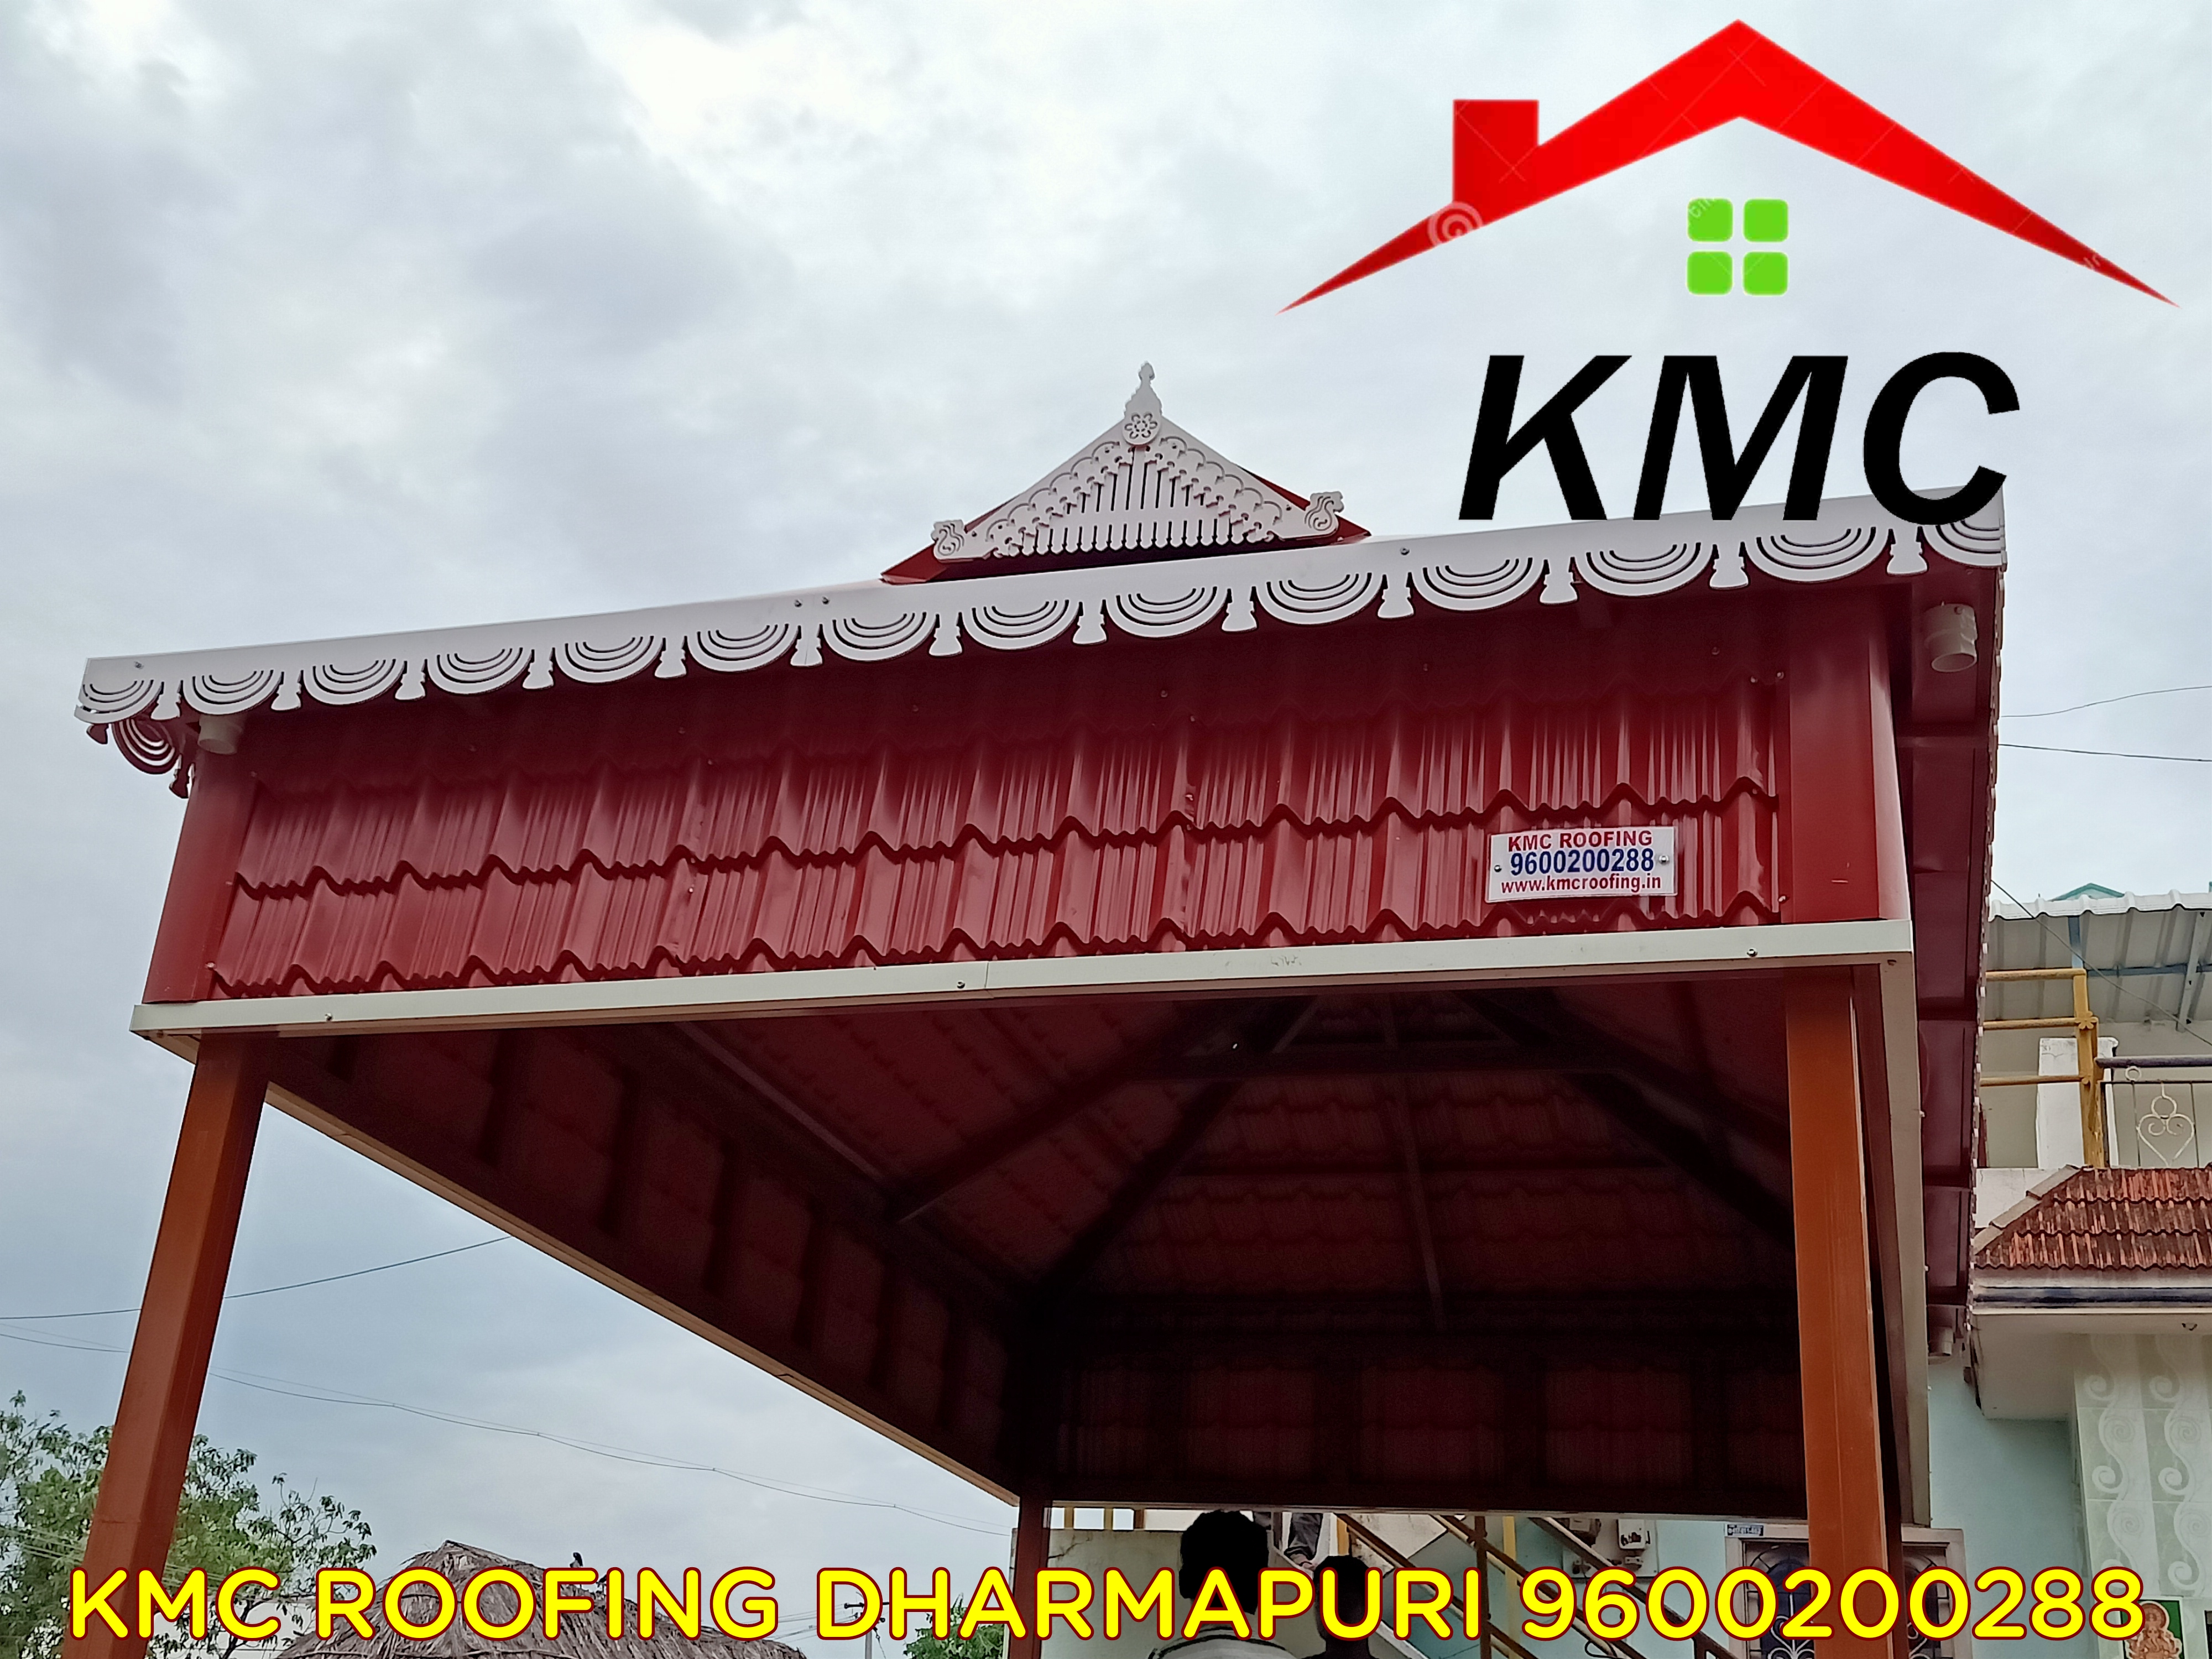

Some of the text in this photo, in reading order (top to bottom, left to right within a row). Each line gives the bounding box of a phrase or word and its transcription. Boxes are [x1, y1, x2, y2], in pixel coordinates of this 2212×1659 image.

[1508, 830, 1652, 852] KMC ROOFING
[1510, 847, 1654, 875] 9600200288
[1501, 873, 1661, 894] www.kmcroofing.in
